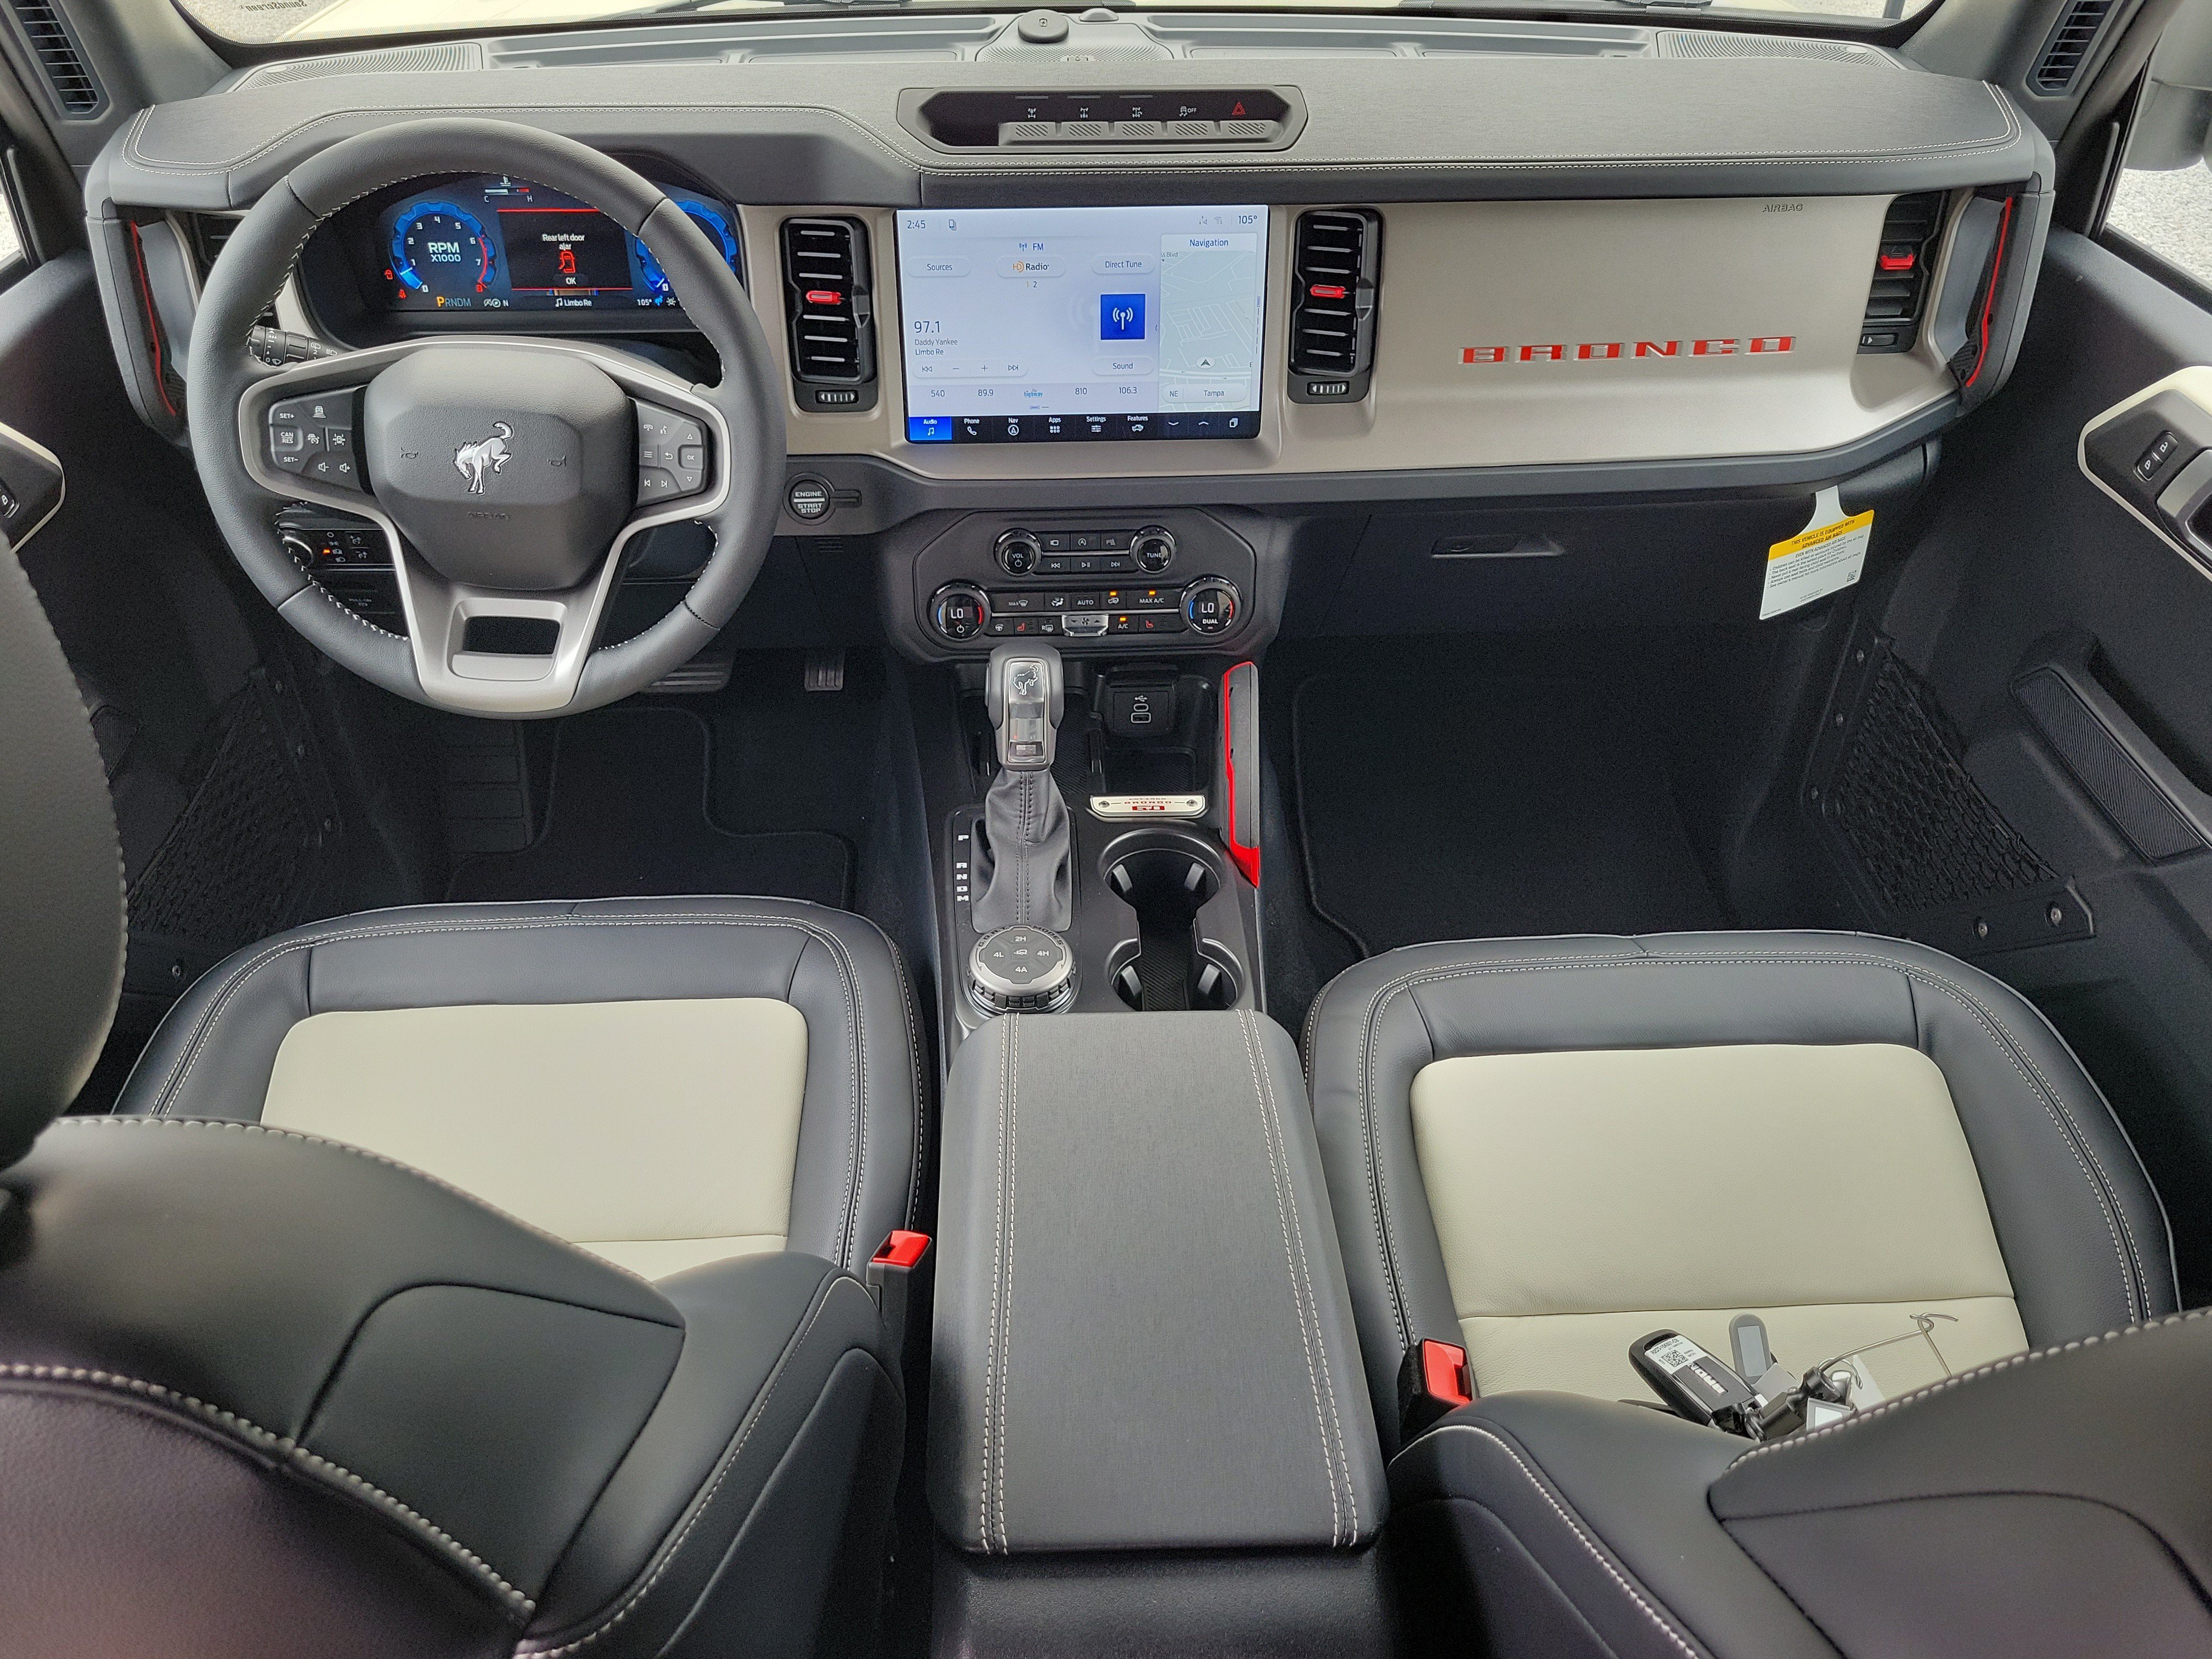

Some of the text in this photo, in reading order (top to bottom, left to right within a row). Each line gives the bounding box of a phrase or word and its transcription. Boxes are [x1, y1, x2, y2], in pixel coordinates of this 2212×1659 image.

[1762, 204, 1803, 212] AIRBAG
[906, 219, 926, 229] 2:45
[1238, 215, 1258, 224] 105°
[428, 242, 460, 253] RPM
[1189, 239, 1229, 248] Navigation
[927, 263, 953, 272] Sources
[914, 321, 941, 333] 97.1
[1458, 336, 1797, 364] BRONCO
[1801, 532, 1819, 542] VEHICLE
[1824, 524, 1843, 534] EQUIPPED
[1802, 537, 1824, 548] ADVANCED
[951, 608, 963, 619] LO
[1201, 603, 1214, 613] LO
[1033, 926, 1064, 945] MODES
